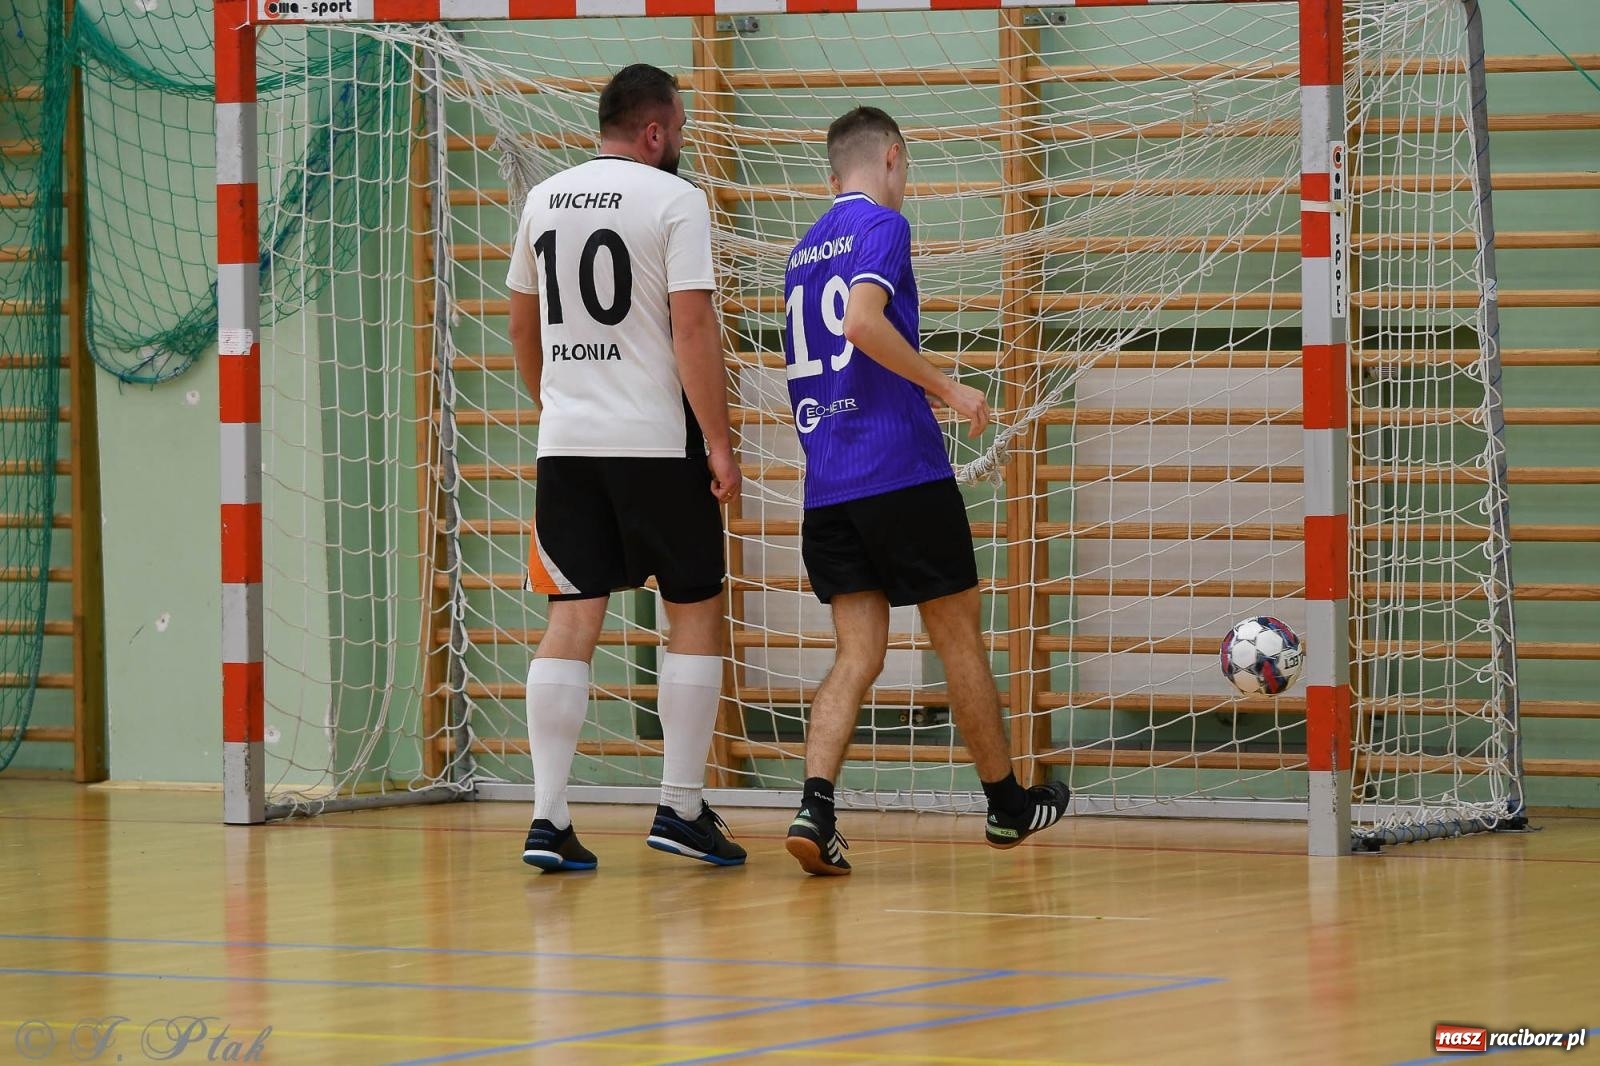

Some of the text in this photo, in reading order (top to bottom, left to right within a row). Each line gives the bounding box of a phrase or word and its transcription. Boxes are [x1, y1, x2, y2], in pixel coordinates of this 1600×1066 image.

[311, 0, 352, 16] sport
[549, 192, 623, 210] WICHER
[533, 228, 633, 326] 10
[786, 274, 855, 381] 19
[552, 343, 622, 361] PŁONIA
